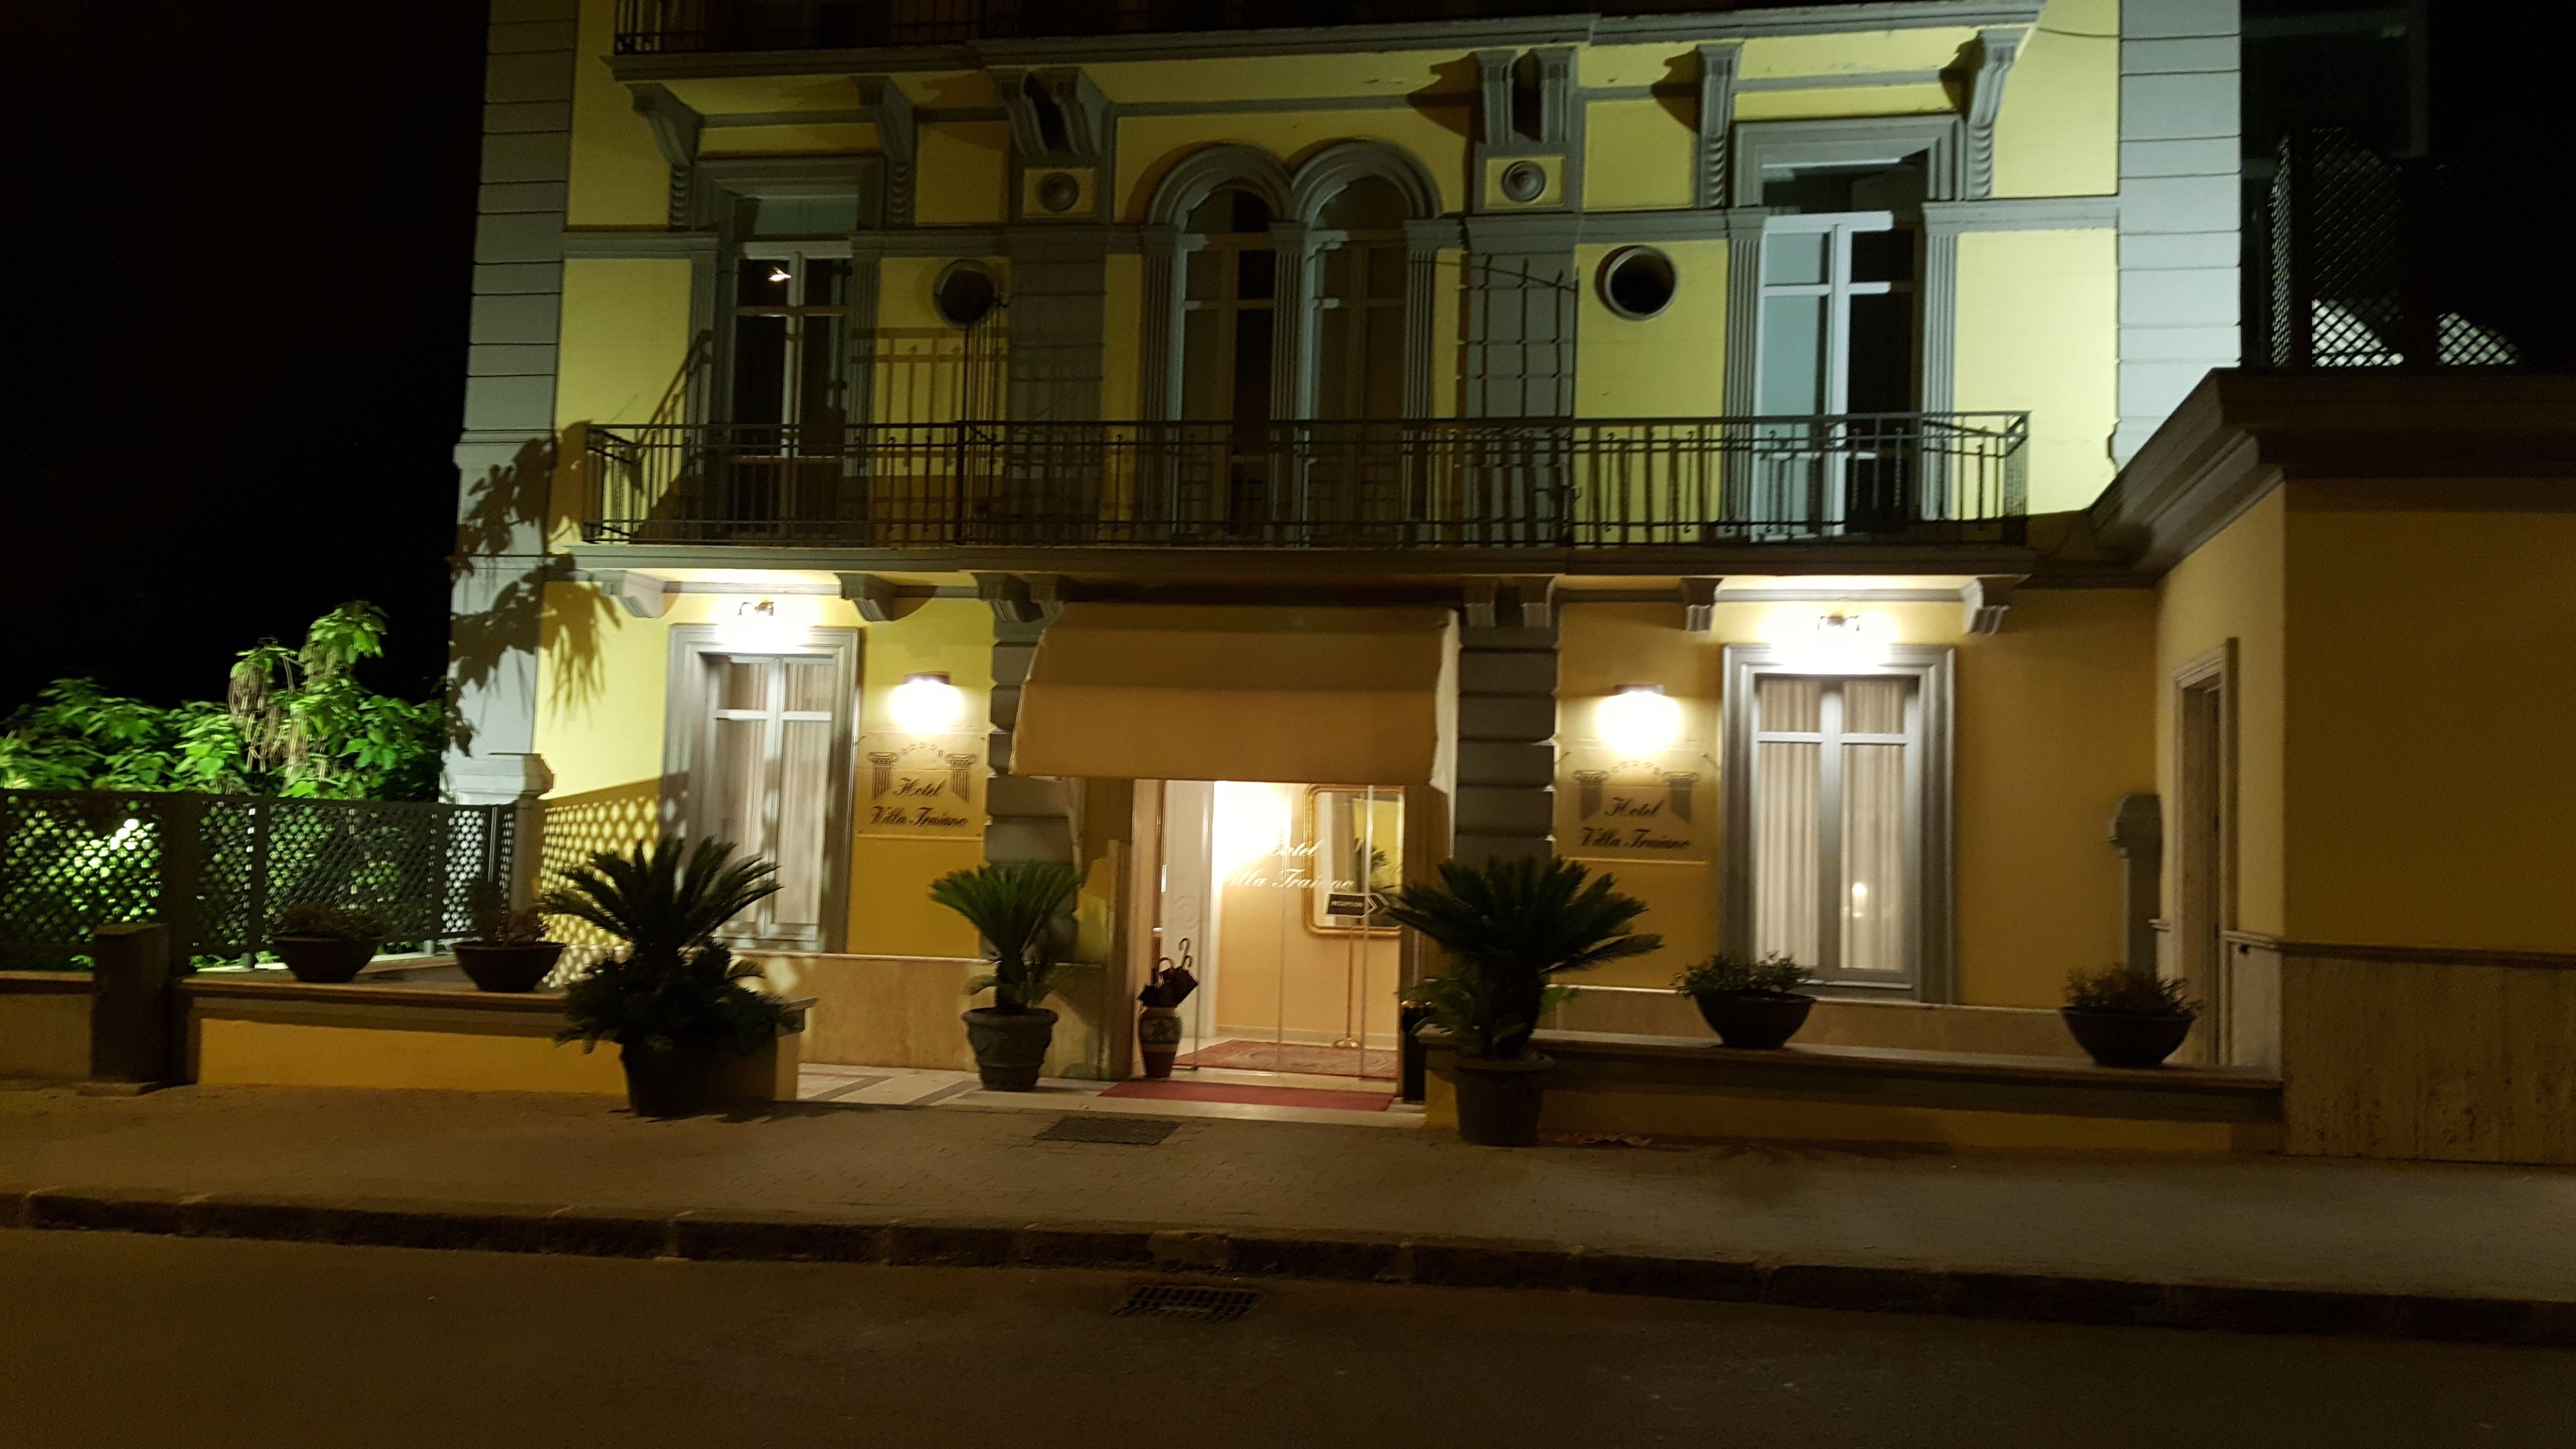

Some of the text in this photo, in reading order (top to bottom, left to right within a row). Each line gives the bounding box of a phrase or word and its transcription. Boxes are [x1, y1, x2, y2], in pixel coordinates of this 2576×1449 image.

[893, 777, 949, 798] Hotel
[869, 805, 906, 825] Villa
[1604, 797, 1665, 818] Hotel
[1580, 826, 1621, 848] Villa
[1228, 868, 1268, 888] illa
